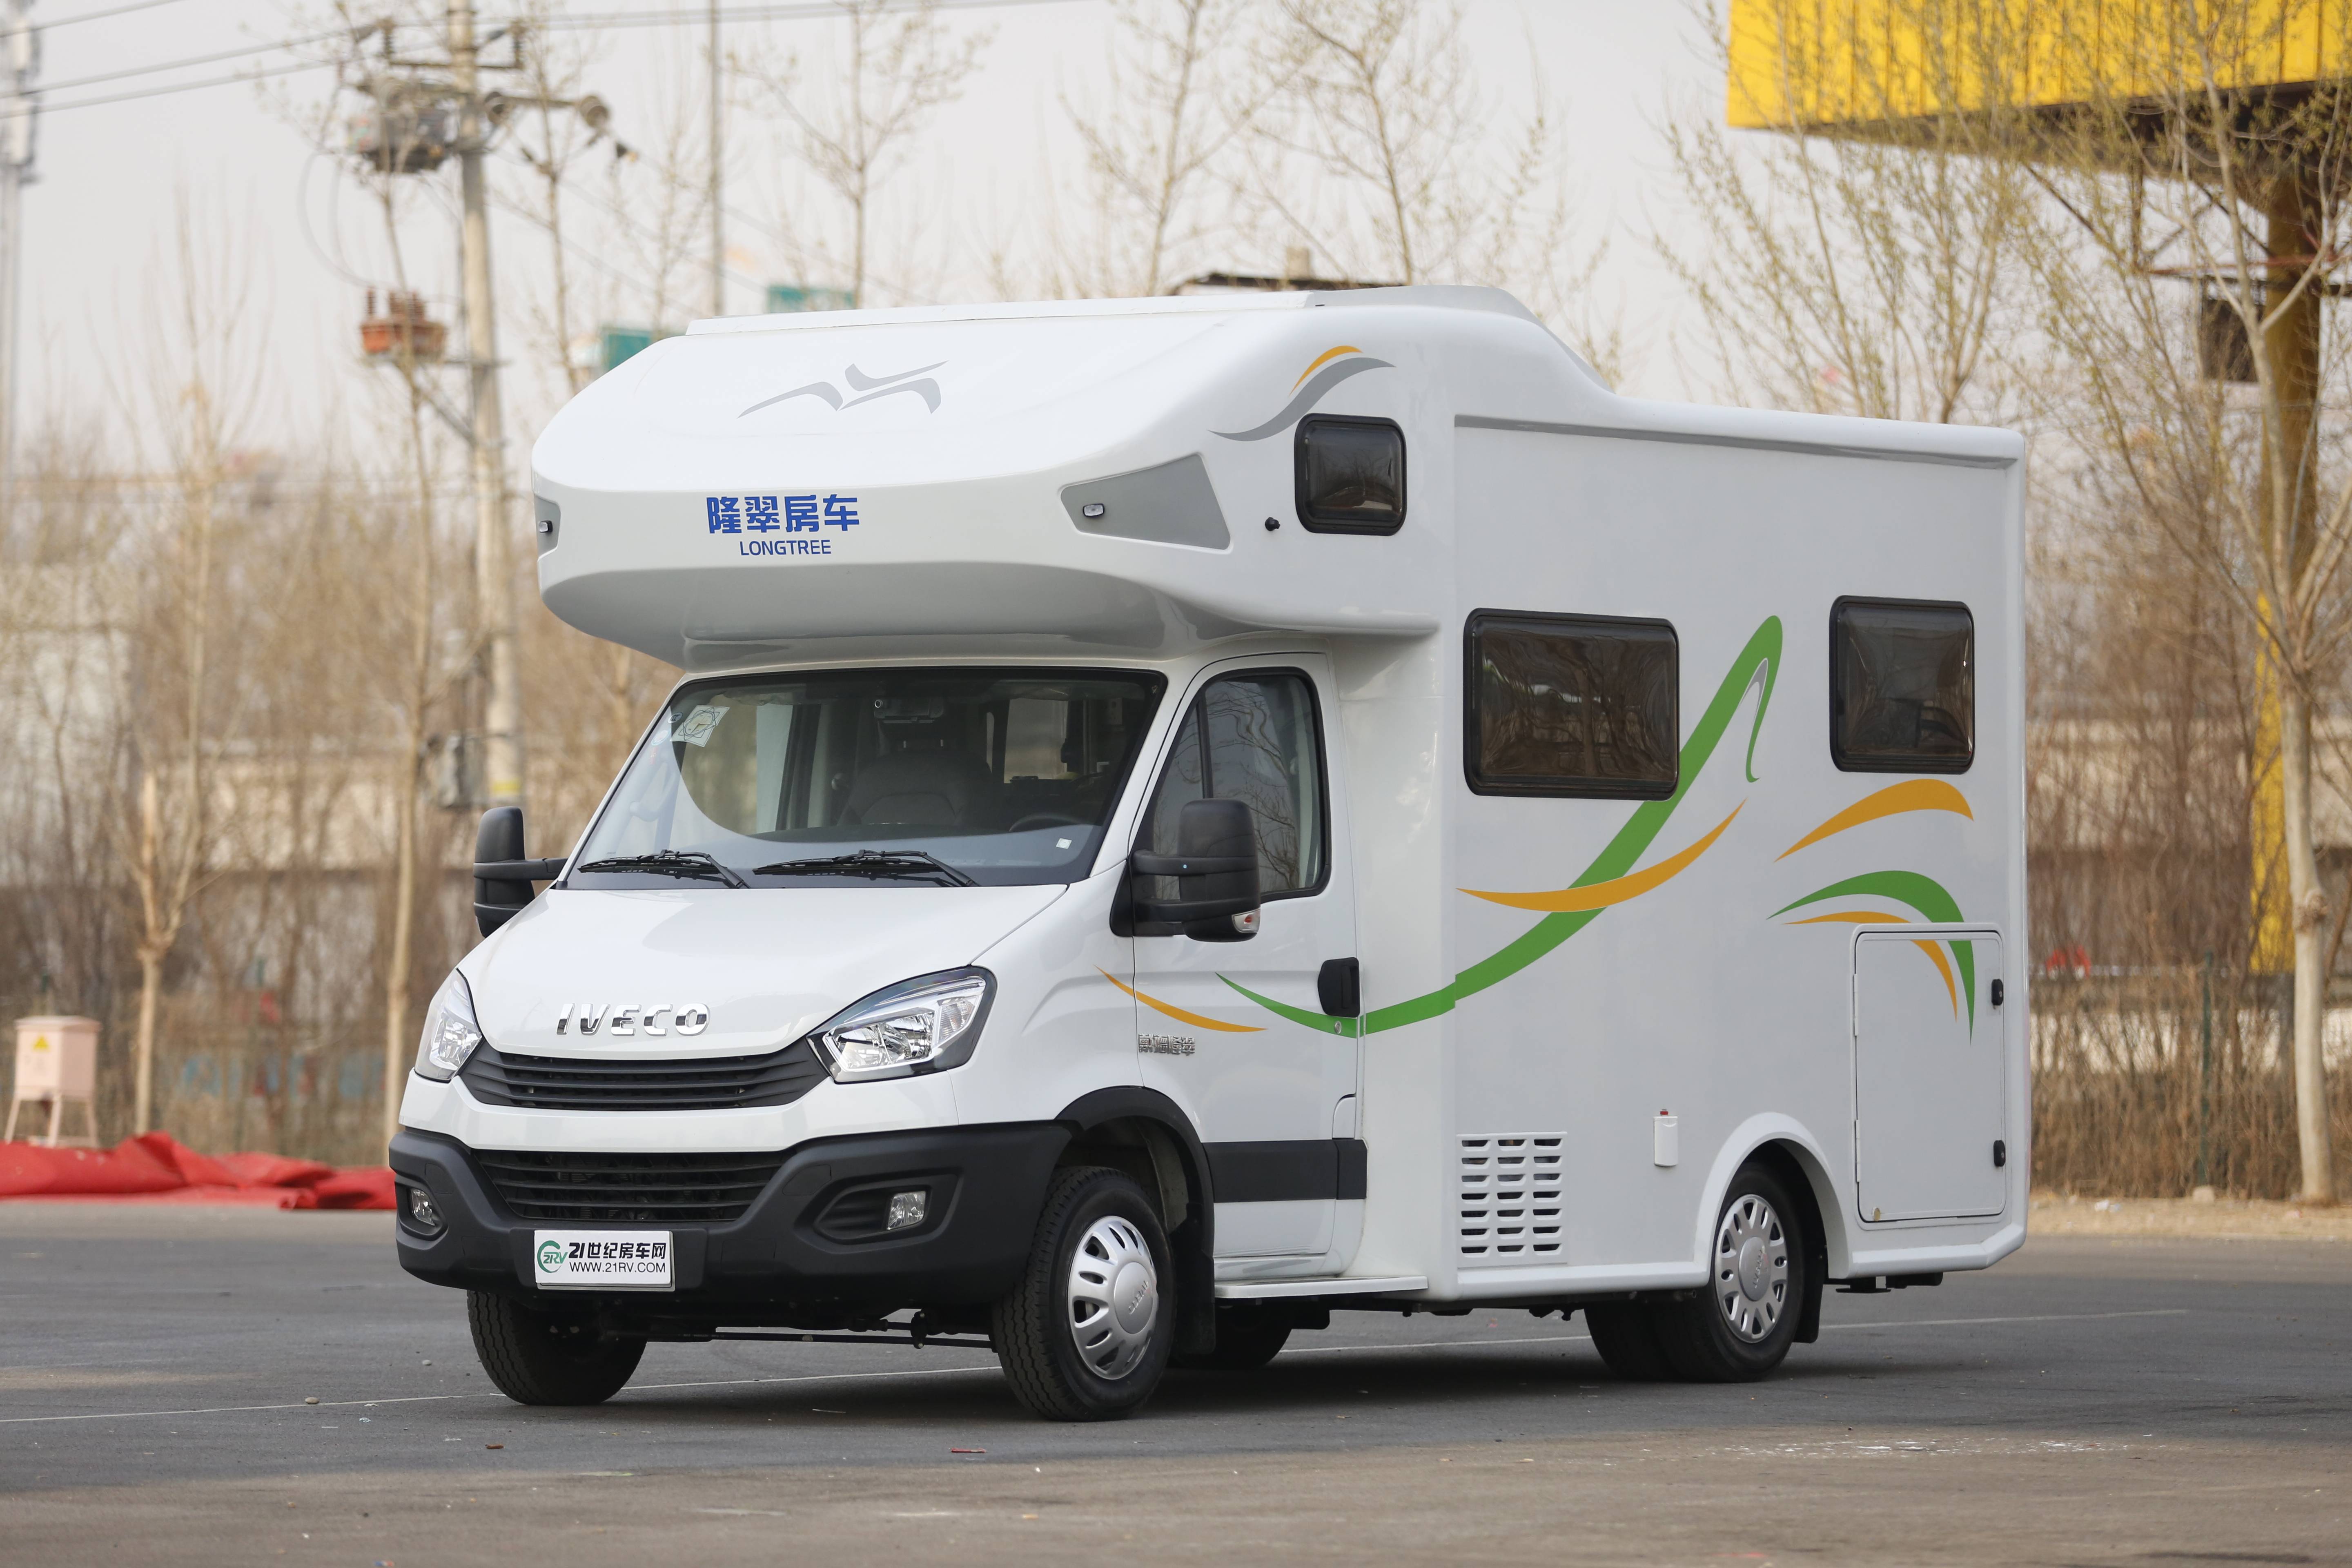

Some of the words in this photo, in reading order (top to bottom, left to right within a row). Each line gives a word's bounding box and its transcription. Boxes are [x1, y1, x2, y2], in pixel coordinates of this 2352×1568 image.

[706, 494, 860, 533] 隆翠房车
[739, 539, 832, 556] LONGTREE
[557, 1003, 710, 1036] IVECO
[568, 1242, 666, 1259] 21世纪房车网
[569, 1262, 666, 1273] WWW.21RV.COM
